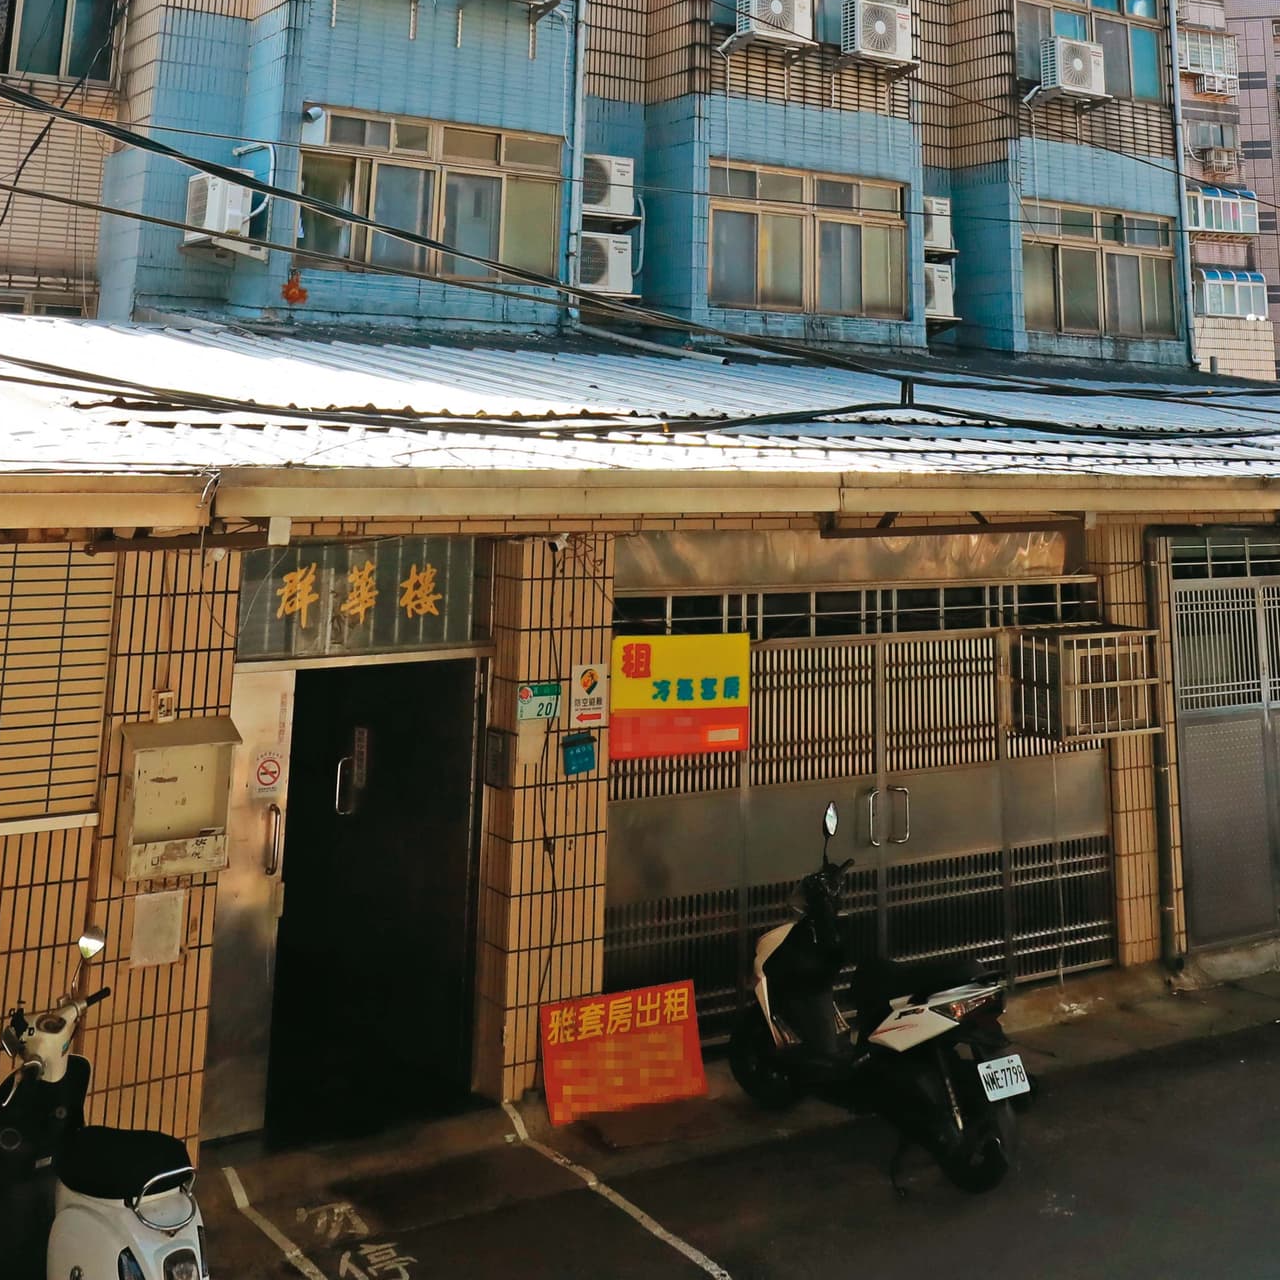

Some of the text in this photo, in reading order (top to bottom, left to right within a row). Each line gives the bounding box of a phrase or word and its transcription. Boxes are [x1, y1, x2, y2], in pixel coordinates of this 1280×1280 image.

[276, 560, 442, 629] 群華樓
[622, 643, 652, 679] 租
[537, 702, 552, 717] 20
[547, 987, 690, 1046] 雅套房出租
